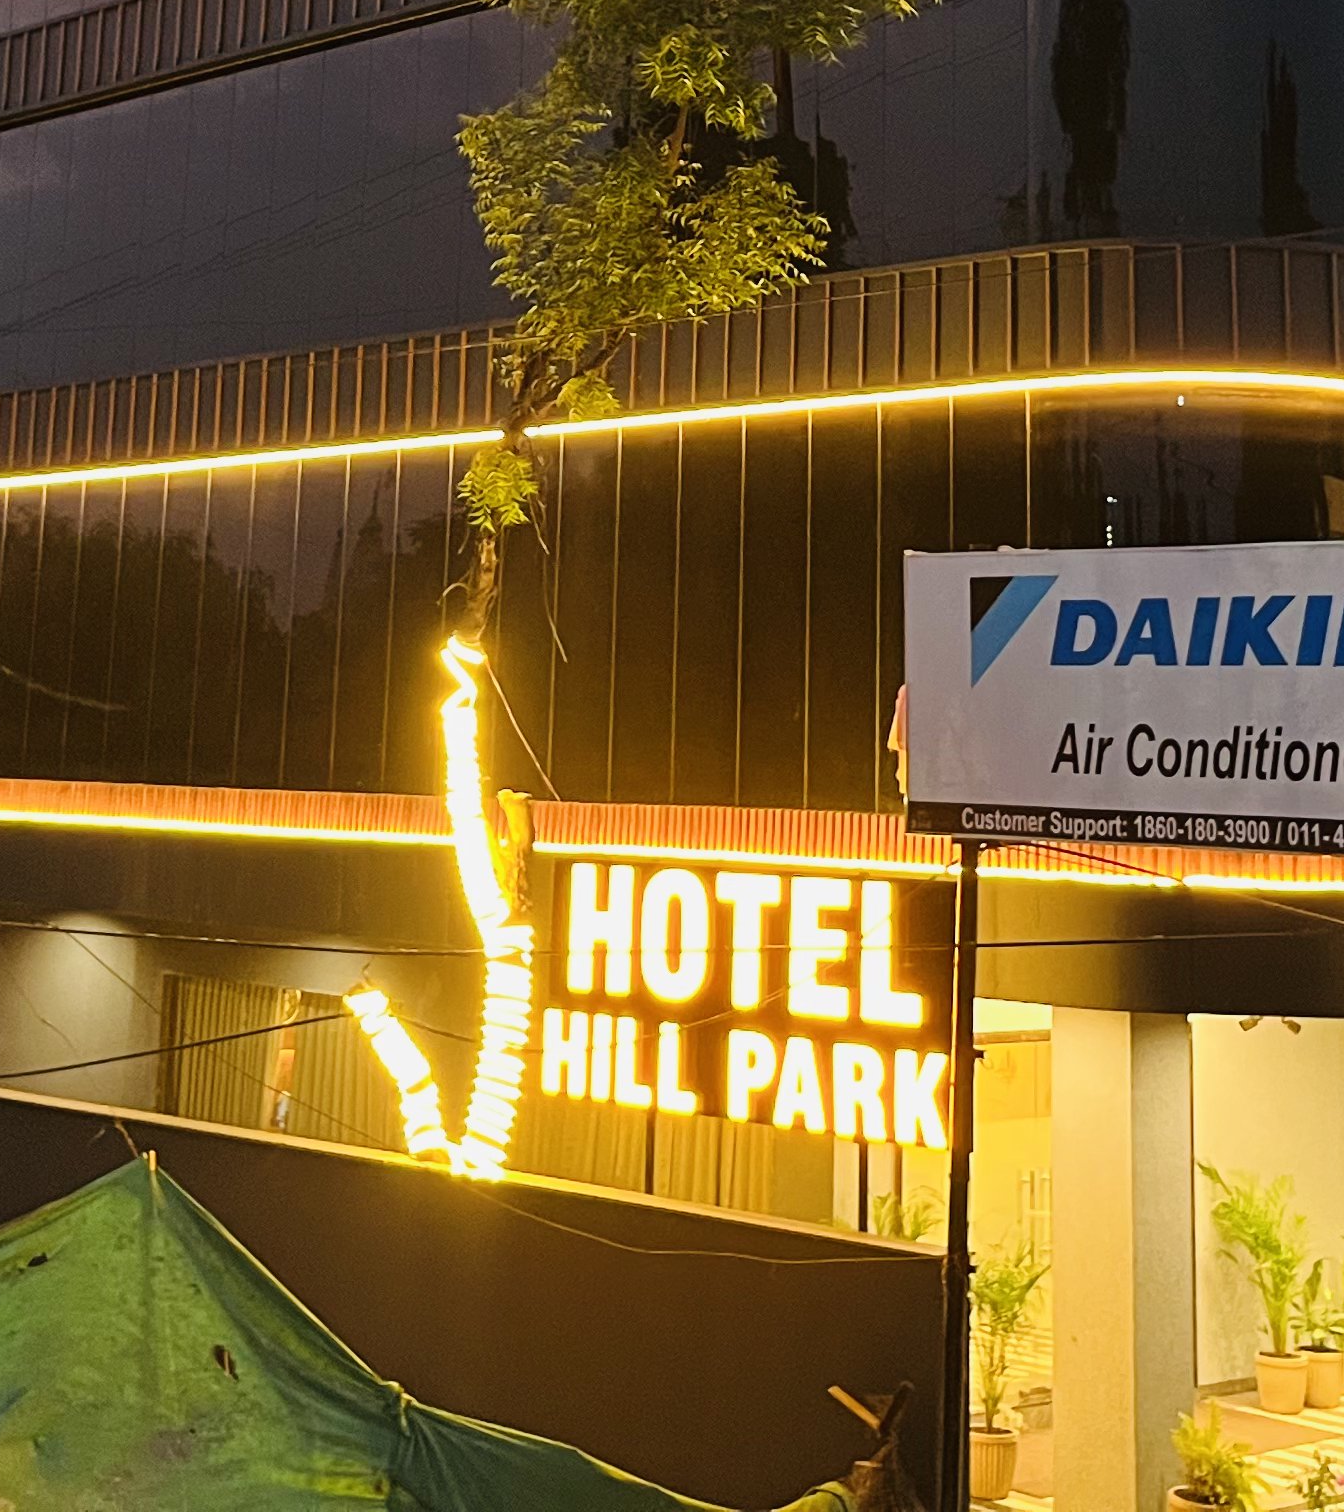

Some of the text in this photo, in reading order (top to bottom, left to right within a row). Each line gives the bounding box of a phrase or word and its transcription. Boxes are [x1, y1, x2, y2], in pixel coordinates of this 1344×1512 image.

[1051, 722, 1114, 775] Air
[961, 806, 1046, 833] Customer
[1049, 811, 1129, 840] Support:
[1133, 814, 1271, 845] 1860-180-3900
[565, 861, 926, 1029] HOTEL
[540, 1006, 949, 1151] HILL PARK
